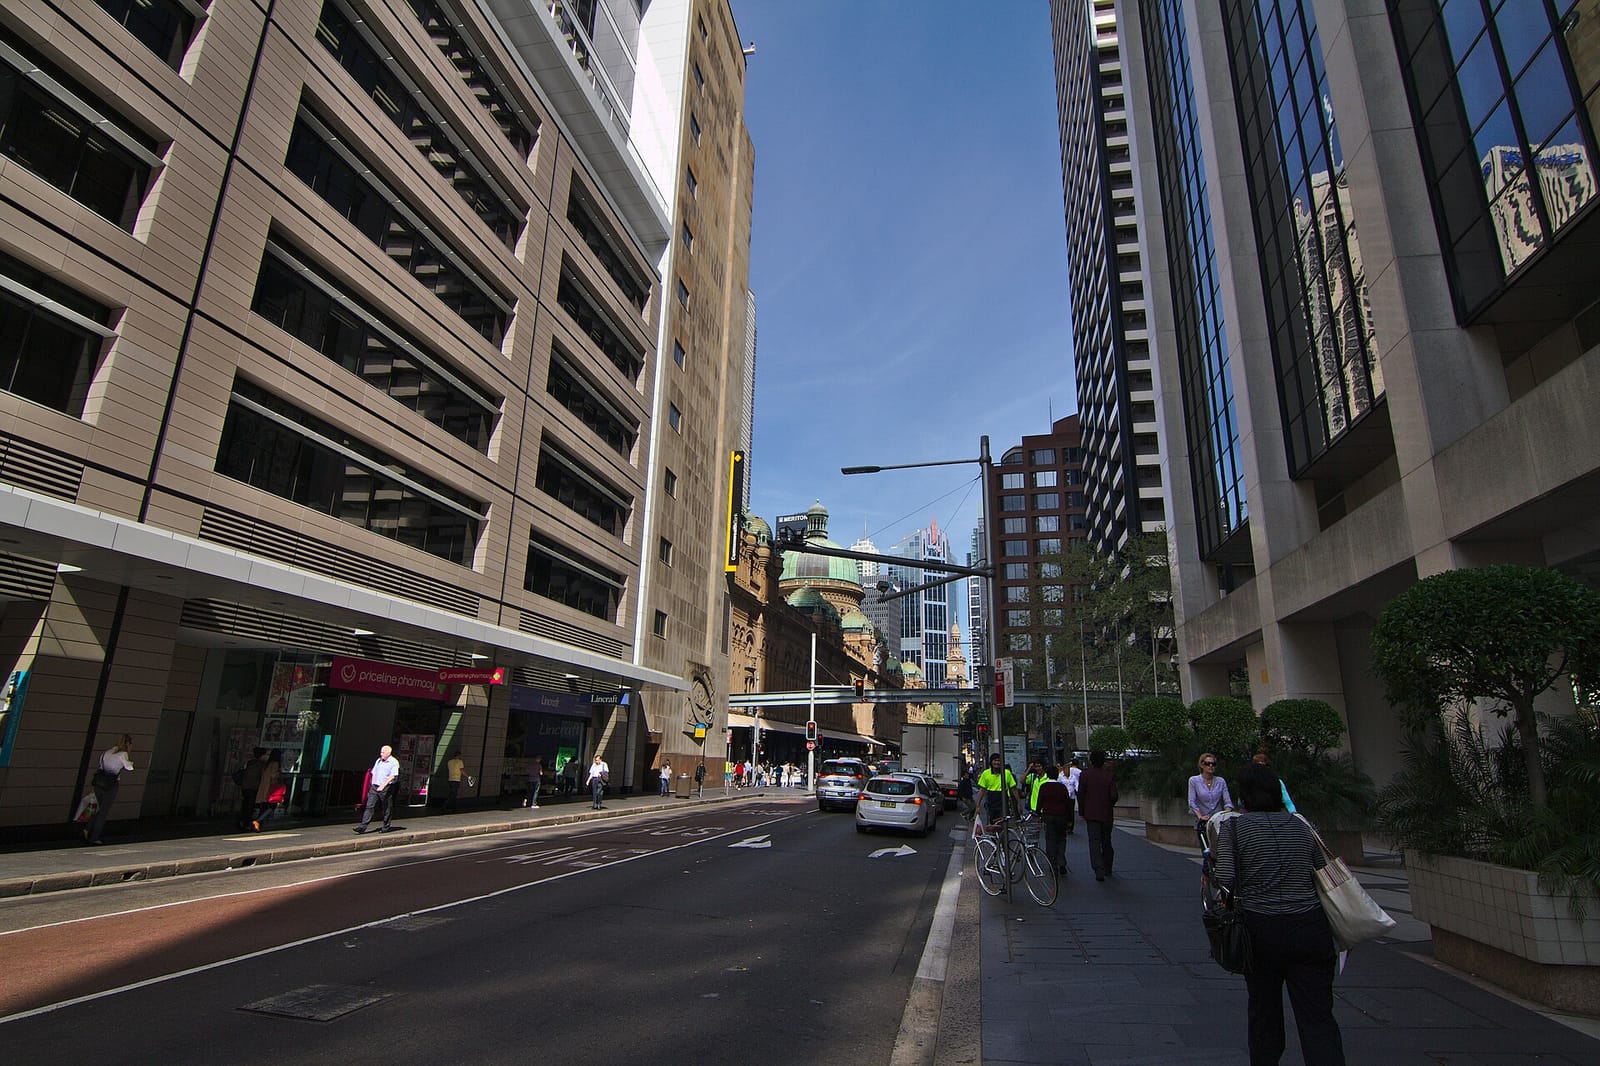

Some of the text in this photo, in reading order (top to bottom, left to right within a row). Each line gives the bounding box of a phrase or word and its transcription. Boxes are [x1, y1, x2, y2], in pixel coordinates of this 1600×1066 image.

[358, 671, 436, 692] priceline pharmacy
[591, 694, 618, 703] Lincraft
